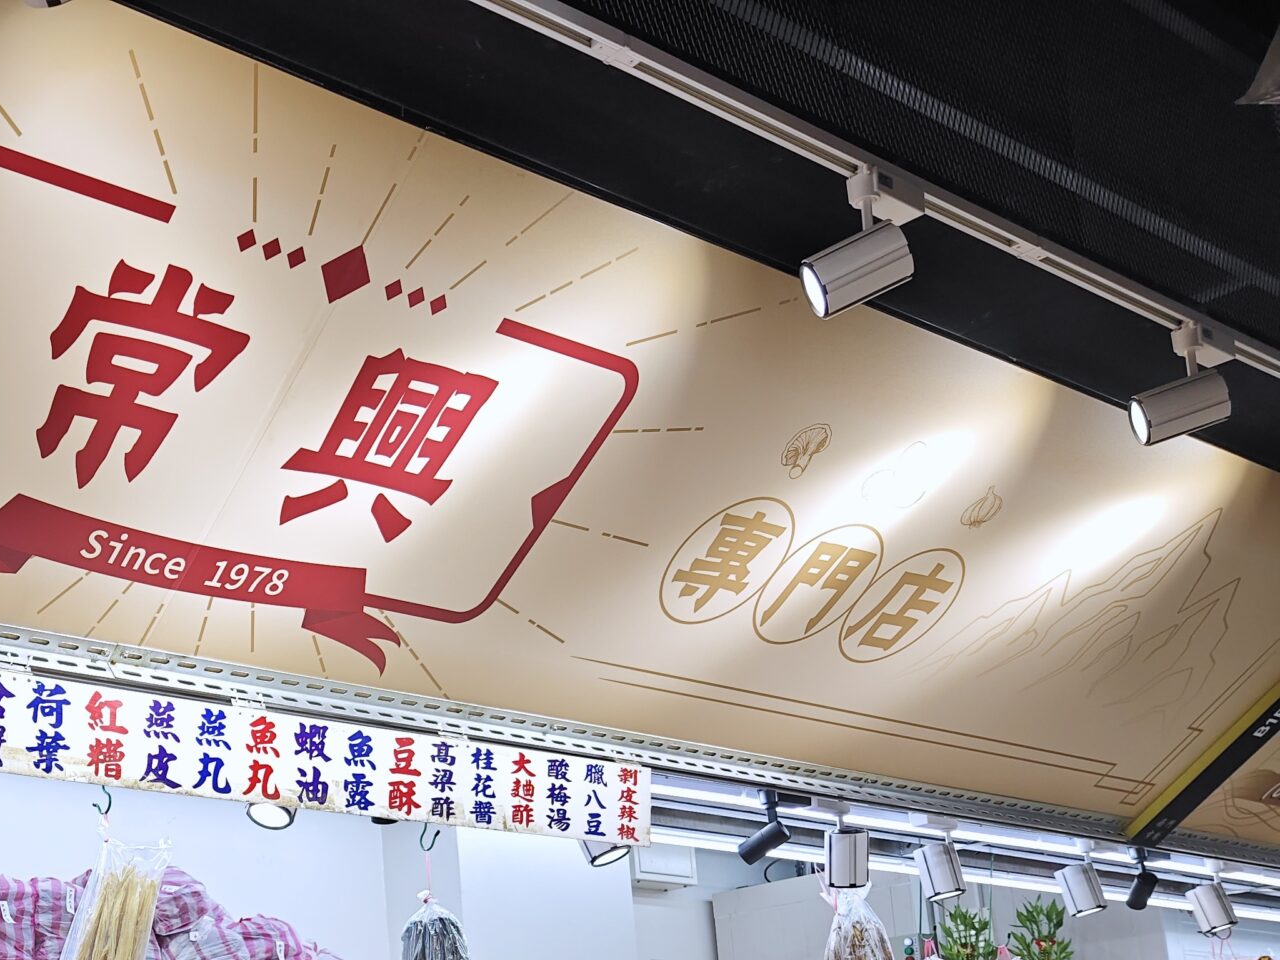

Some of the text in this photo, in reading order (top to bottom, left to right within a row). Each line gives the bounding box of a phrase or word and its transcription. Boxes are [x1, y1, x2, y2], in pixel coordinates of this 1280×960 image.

[36, 259, 500, 544] 常興
[80, 529, 290, 598] Since 1978
[672, 510, 954, 652] 專門店
[26, 681, 71, 774] 荷葉
[139, 699, 182, 790] 燕皮
[192, 708, 232, 795] 燕丸
[242, 715, 281, 801] 魚丸
[294, 722, 332, 806] 蝦油
[343, 730, 377, 811] 魚露
[388, 737, 422, 817] 豆酥
[470, 747, 498, 825] 桂花醬
[546, 758, 572, 832] 酸梅湯
[617, 767, 640, 843] 剝皮辣椒
